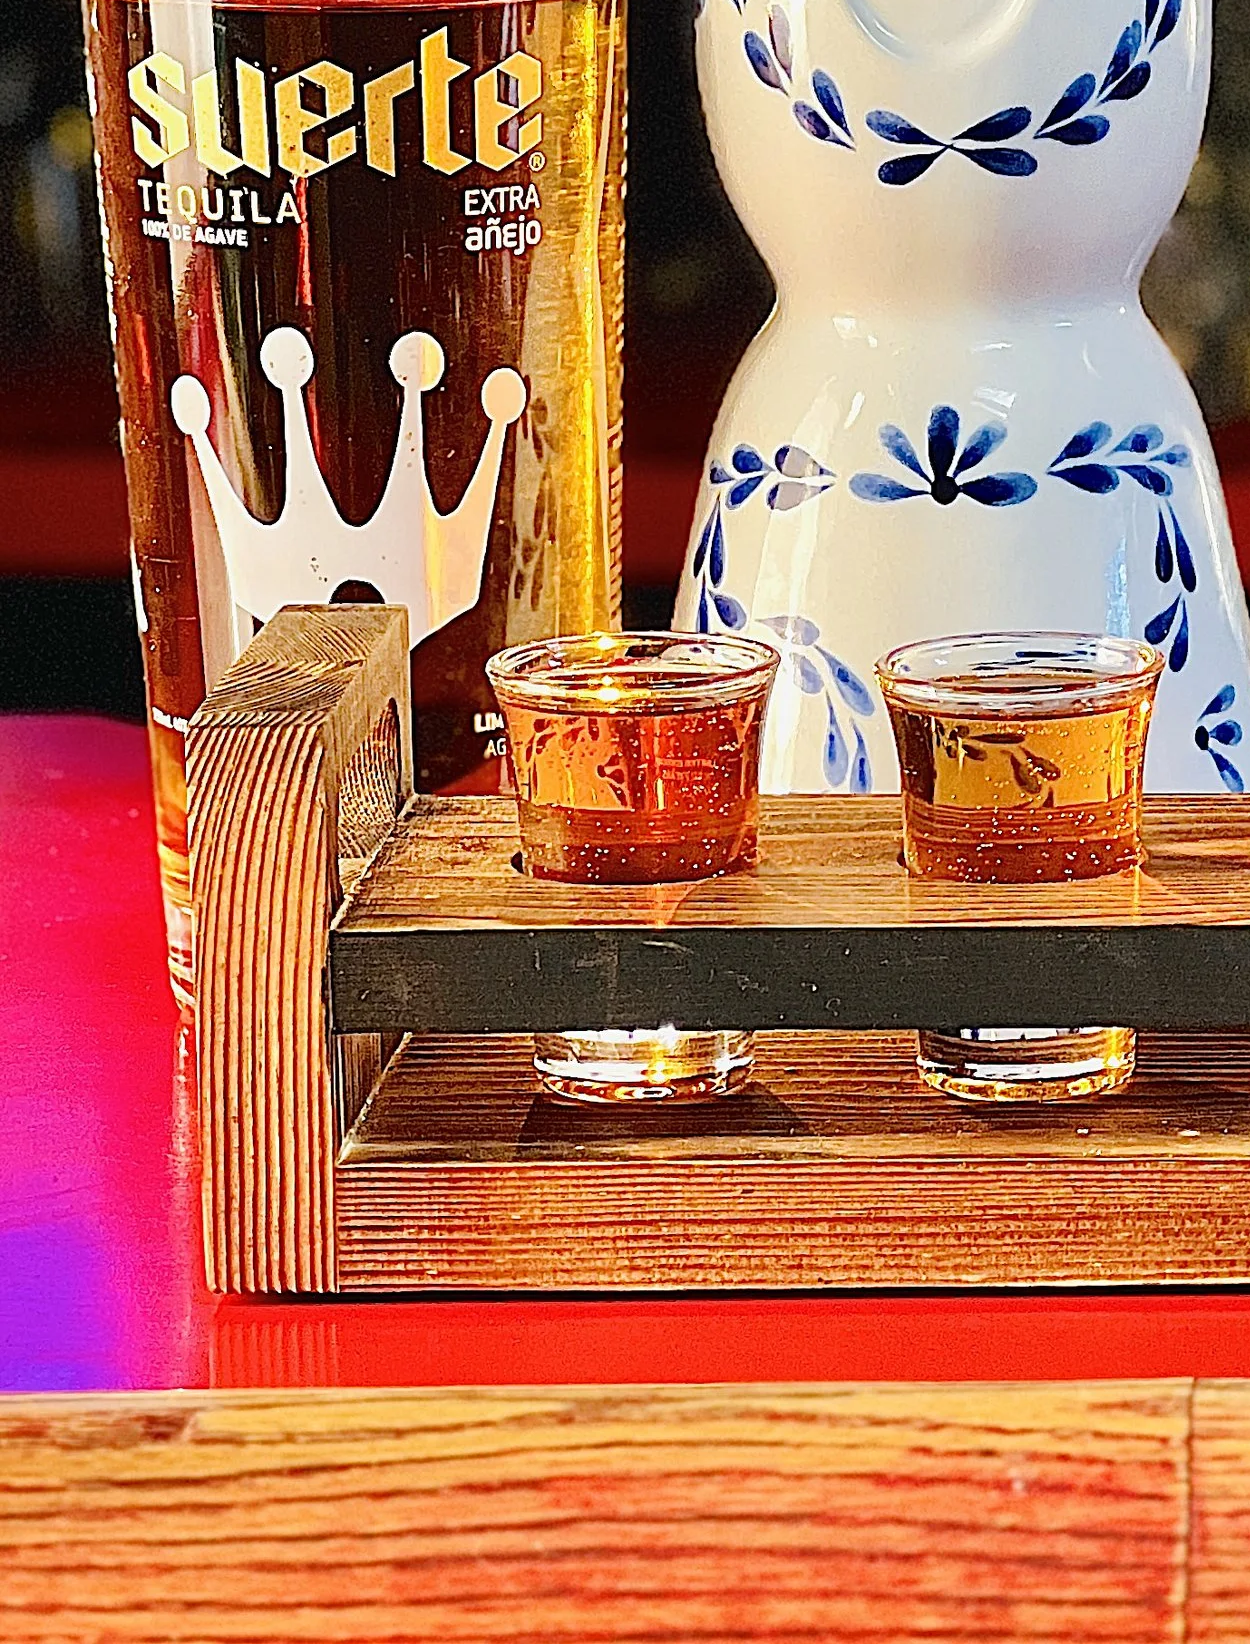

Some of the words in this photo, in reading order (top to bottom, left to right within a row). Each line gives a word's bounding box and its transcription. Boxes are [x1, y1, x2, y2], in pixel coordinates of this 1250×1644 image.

[128, 26, 543, 179] suerte
[137, 179, 302, 225] TEQUILA
[464, 183, 541, 216] EXTRA
[142, 219, 170, 239] 100%
[173, 223, 191, 241] DE
[194, 226, 249, 247] AGAVE
[464, 215, 542, 256] añejo
